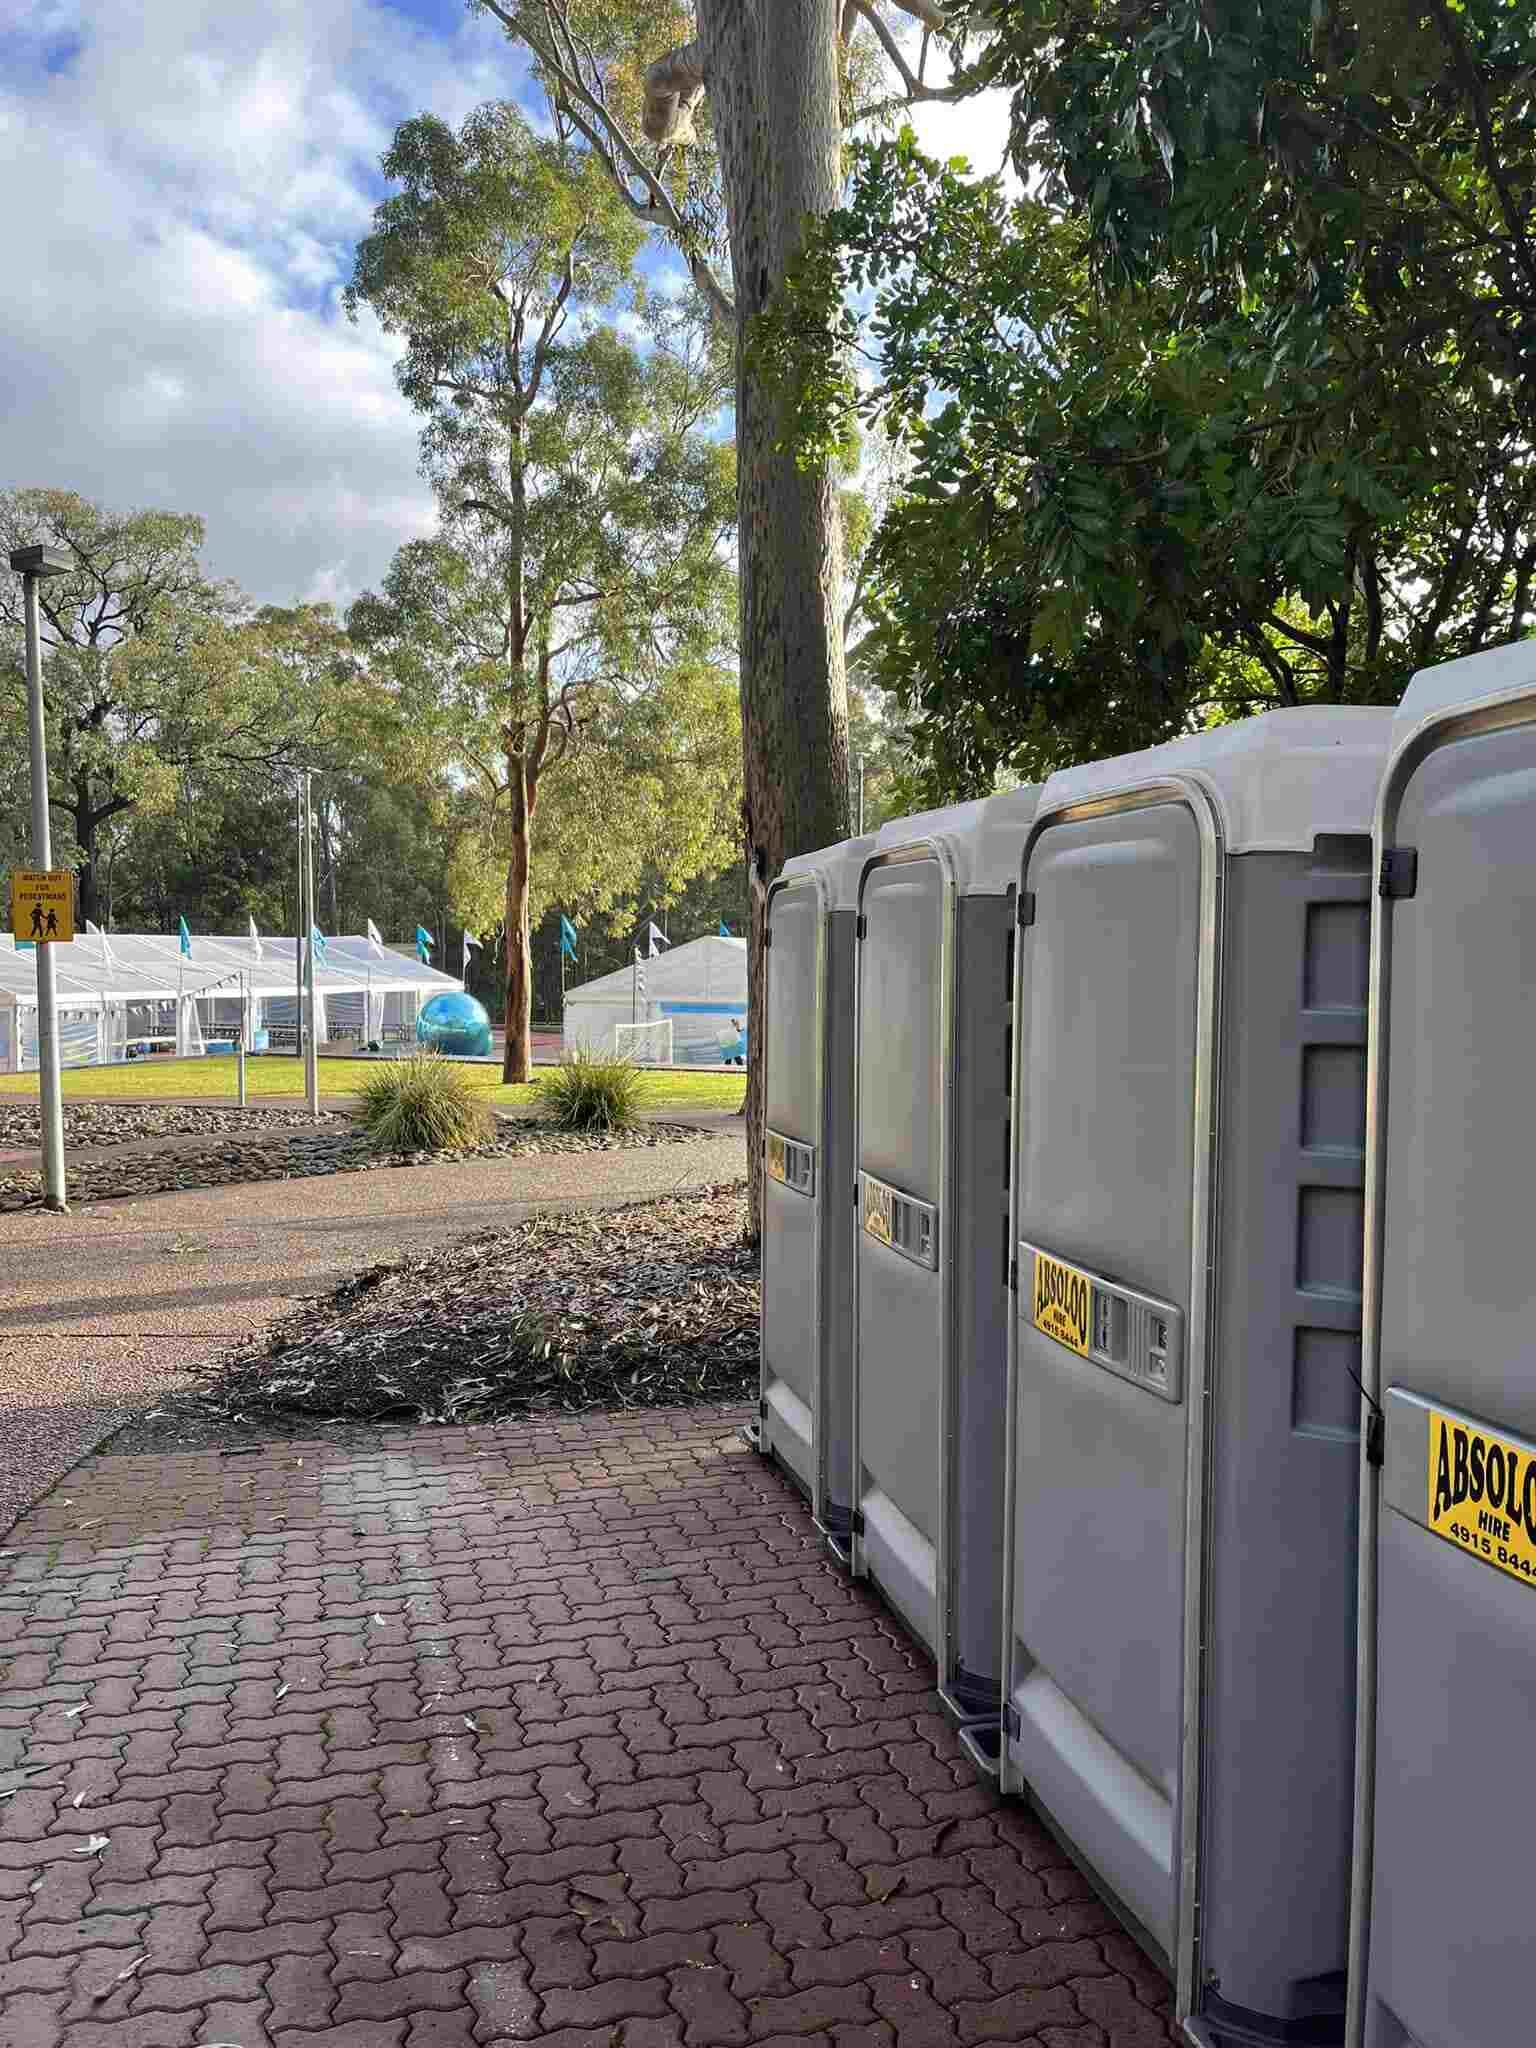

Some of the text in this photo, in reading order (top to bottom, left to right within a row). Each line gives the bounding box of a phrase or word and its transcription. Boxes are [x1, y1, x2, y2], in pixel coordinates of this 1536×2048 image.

[1036, 1255, 1087, 1345] ABSOLOO
[1450, 1523, 1491, 1555] 4915
[1478, 1510, 1511, 1541] HIRE
